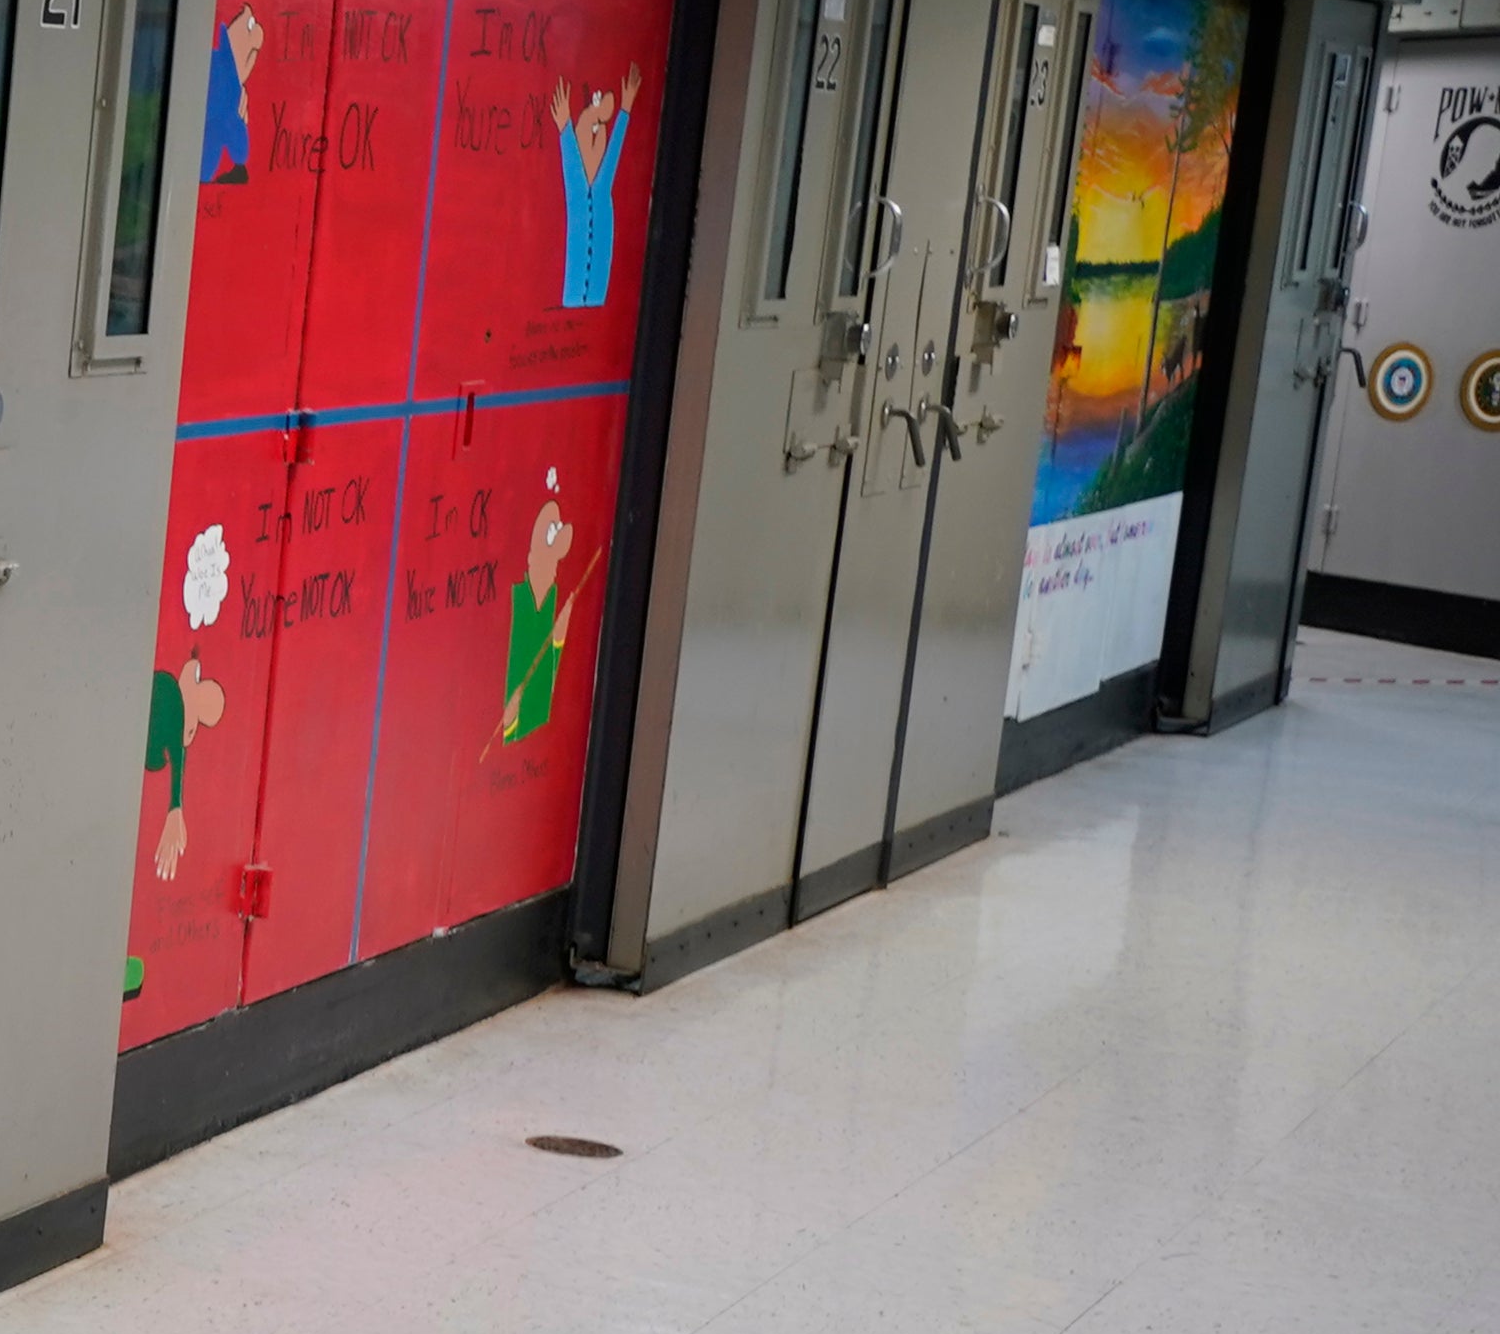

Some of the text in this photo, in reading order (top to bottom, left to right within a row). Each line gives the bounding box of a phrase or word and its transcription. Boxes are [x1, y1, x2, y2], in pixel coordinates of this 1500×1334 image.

[381, 10, 412, 63] OK
[522, 10, 552, 67] OK
[815, 33, 841, 90] 22
[1030, 58, 1049, 105] 23
[339, 102, 379, 171] OK
[520, 92, 548, 150] OK
[302, 487, 336, 534] NOT
[341, 476, 370, 526] OK
[469, 487, 493, 539] OK
[299, 572, 331, 623] NOT
[329, 569, 356, 619] OK
[445, 564, 479, 609] NOT
[476, 559, 498, 606] OK
